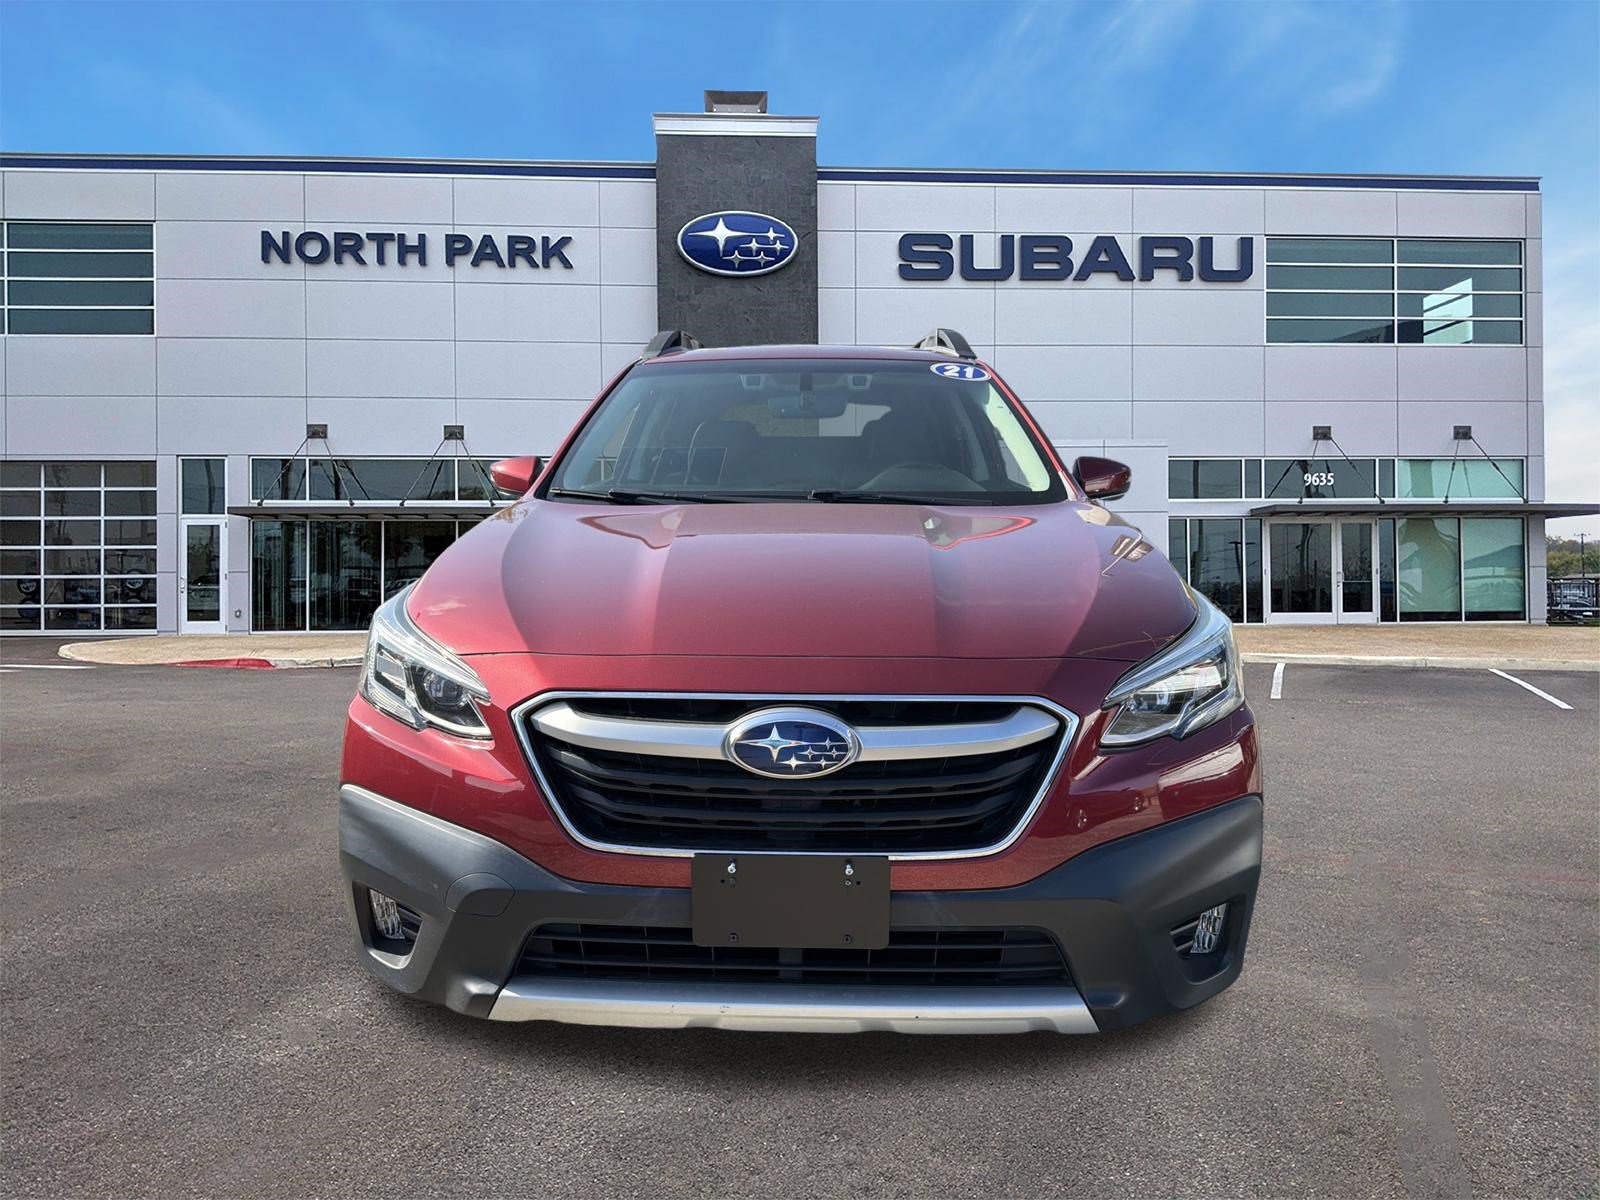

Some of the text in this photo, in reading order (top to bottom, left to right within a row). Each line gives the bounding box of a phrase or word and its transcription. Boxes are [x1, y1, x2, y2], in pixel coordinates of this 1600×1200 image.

[261, 230, 574, 269] NORTH PARK
[898, 233, 1254, 282] SUBARU
[943, 365, 974, 378] 21
[1304, 472, 1334, 486] 9635
